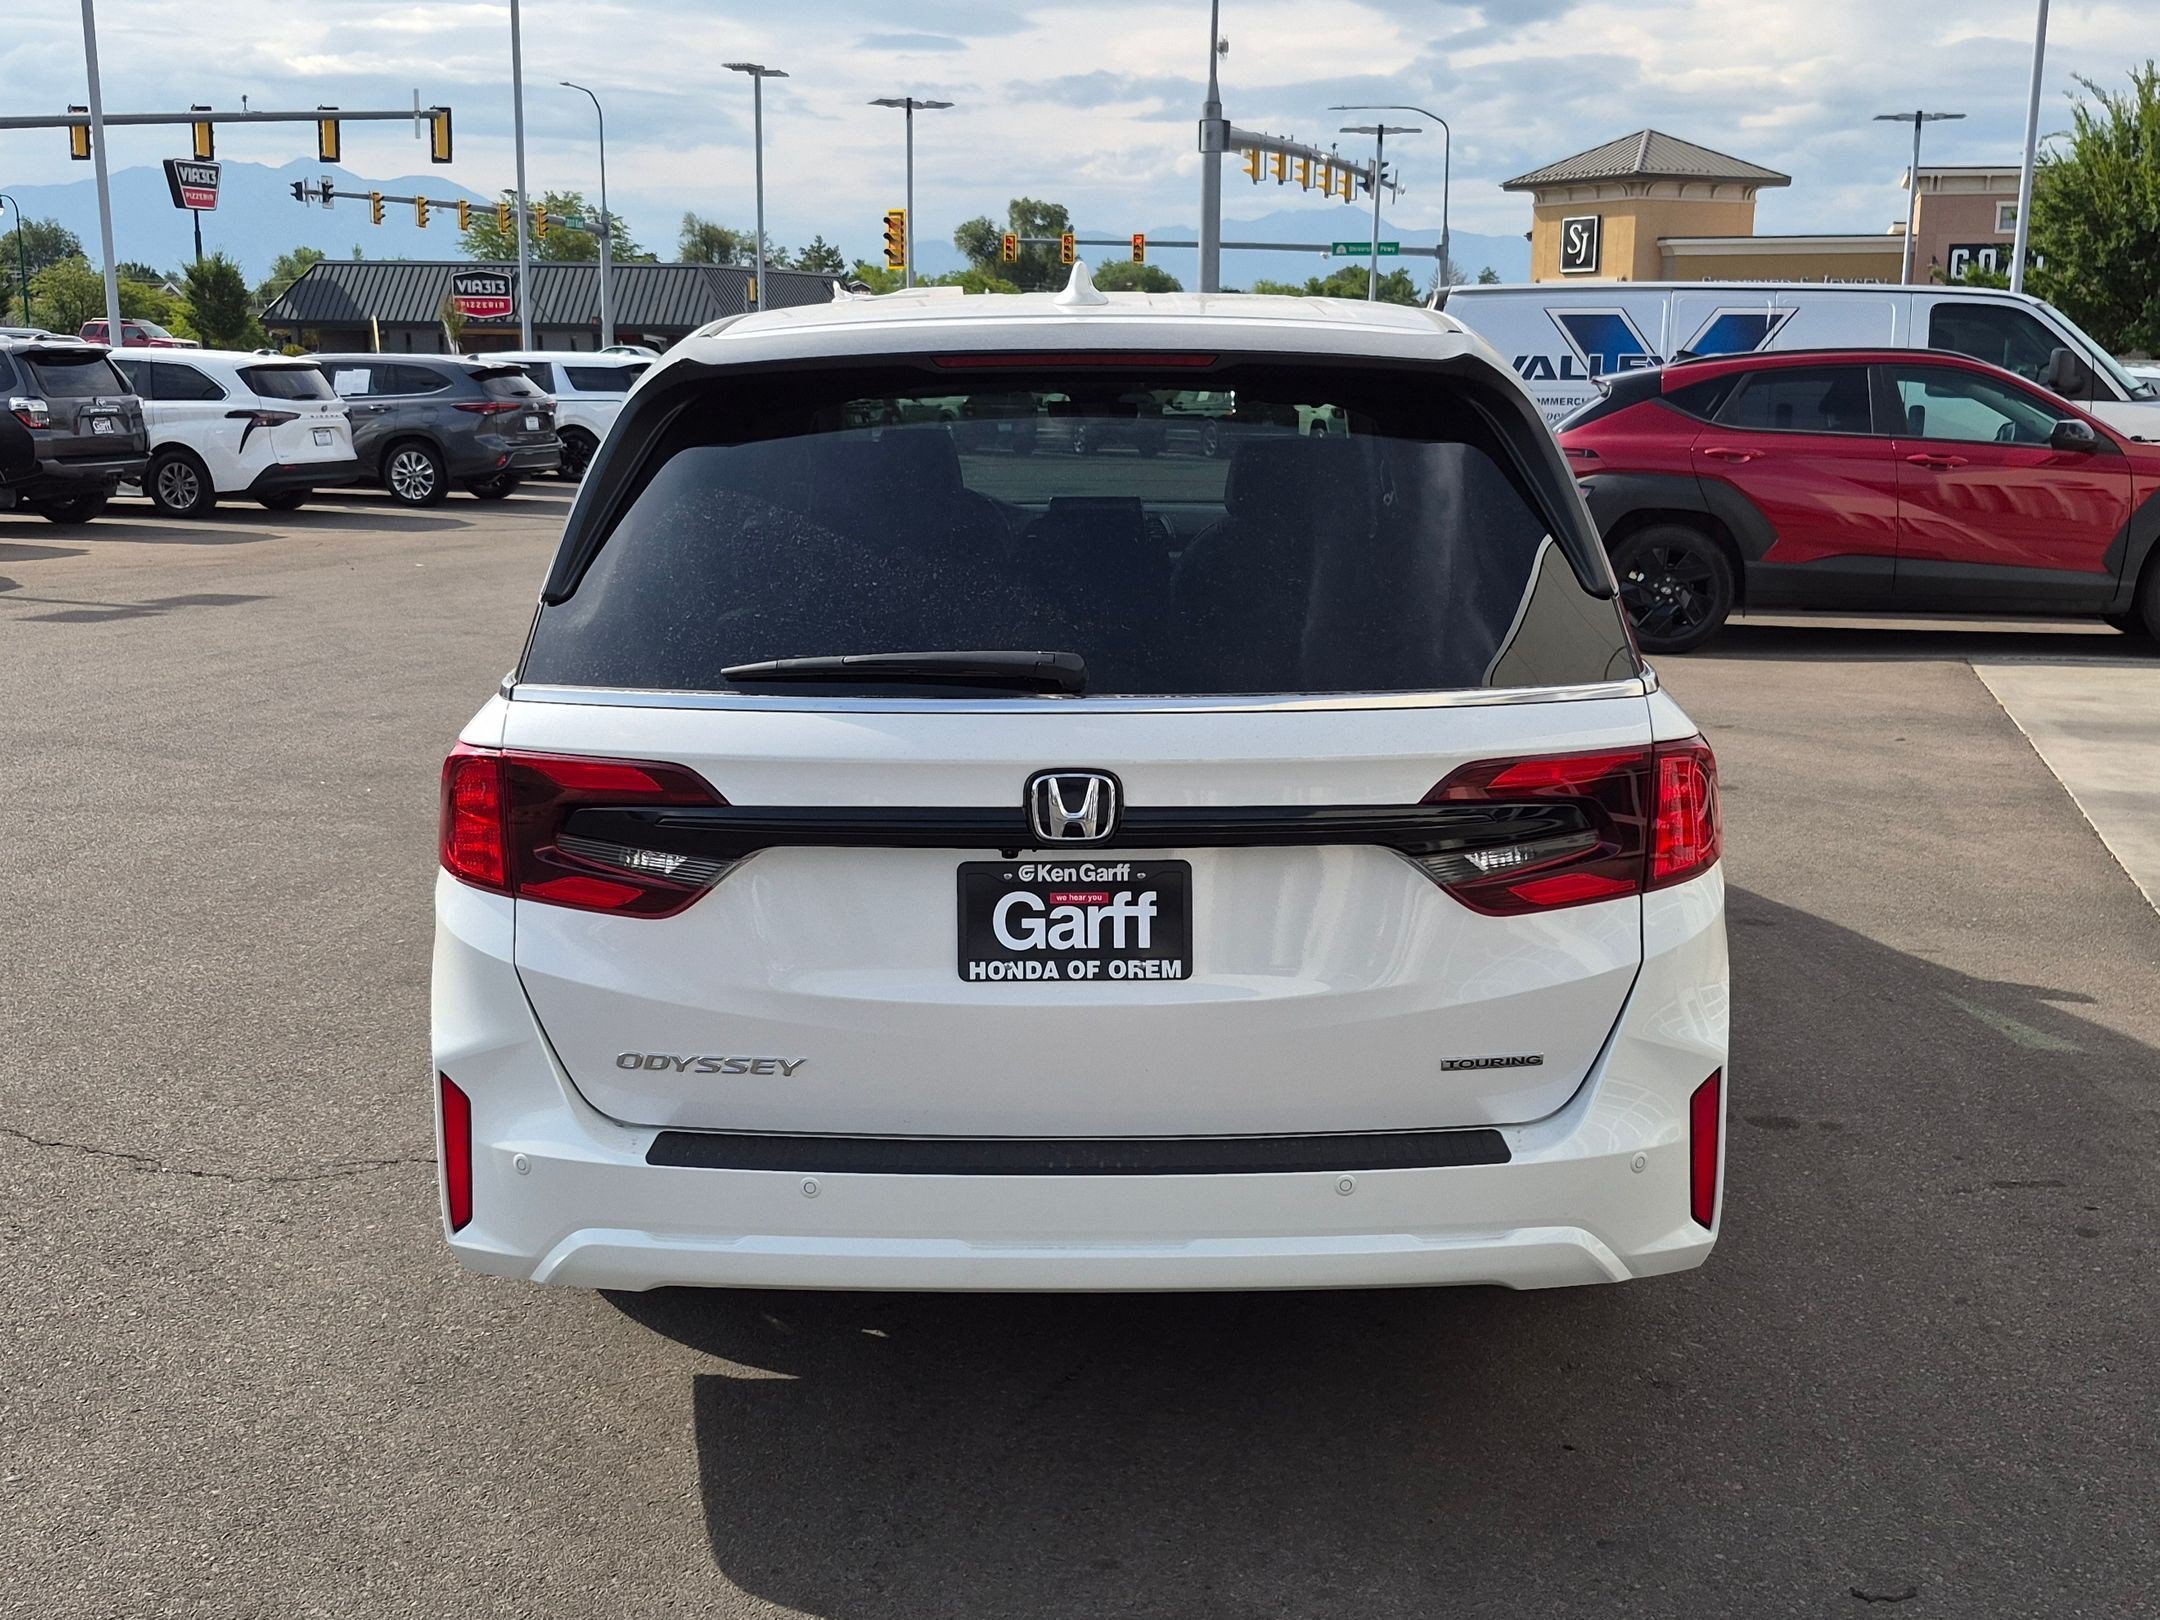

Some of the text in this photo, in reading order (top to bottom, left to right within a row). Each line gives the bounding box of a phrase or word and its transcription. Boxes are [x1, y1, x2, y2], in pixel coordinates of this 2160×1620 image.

[1037, 863, 1131, 882] Ken Garff
[992, 890, 1158, 951] Garff
[968, 959, 1182, 981] HONDA OF OREM
[616, 1052, 808, 1077] ODYSSEY
[1445, 1055, 1541, 1069] TOURING
